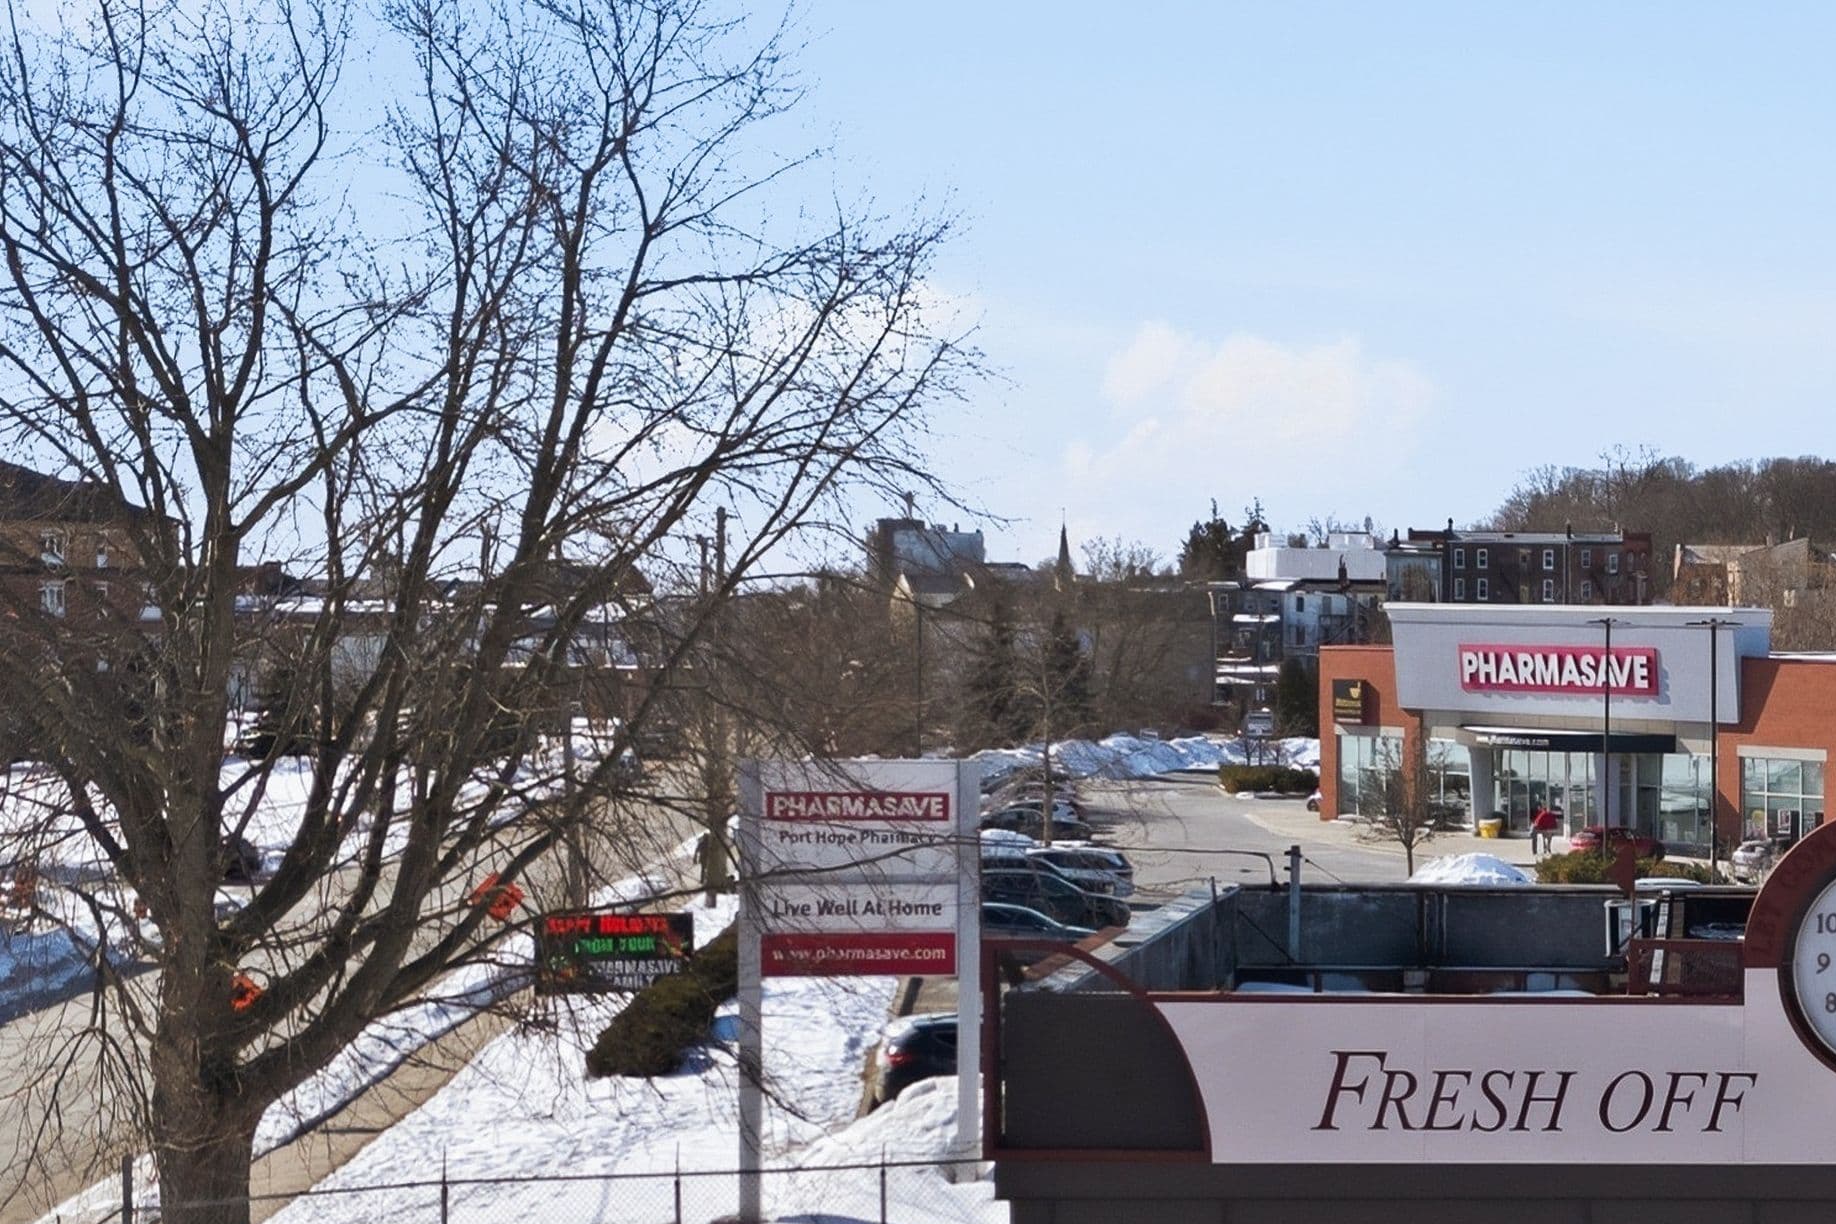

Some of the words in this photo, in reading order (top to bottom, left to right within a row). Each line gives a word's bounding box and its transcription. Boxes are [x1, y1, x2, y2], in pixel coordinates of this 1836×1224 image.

[1462, 651, 1649, 688] PHARMASAVE
[773, 796, 944, 817] PHARMASAVE
[780, 831, 812, 843] Port
[816, 831, 856, 846] Hope
[773, 900, 811, 916] Live
[816, 900, 858, 916] Well
[862, 902, 885, 916] At
[889, 901, 942, 916] Home
[773, 946, 946, 963] ww.pharmasave.com
[1816, 953, 1831, 974] 9
[589, 960, 680, 976] ARMASAVE
[1310, 1050, 1579, 1132] FRESH
[1599, 1070, 1757, 1133] OFF
